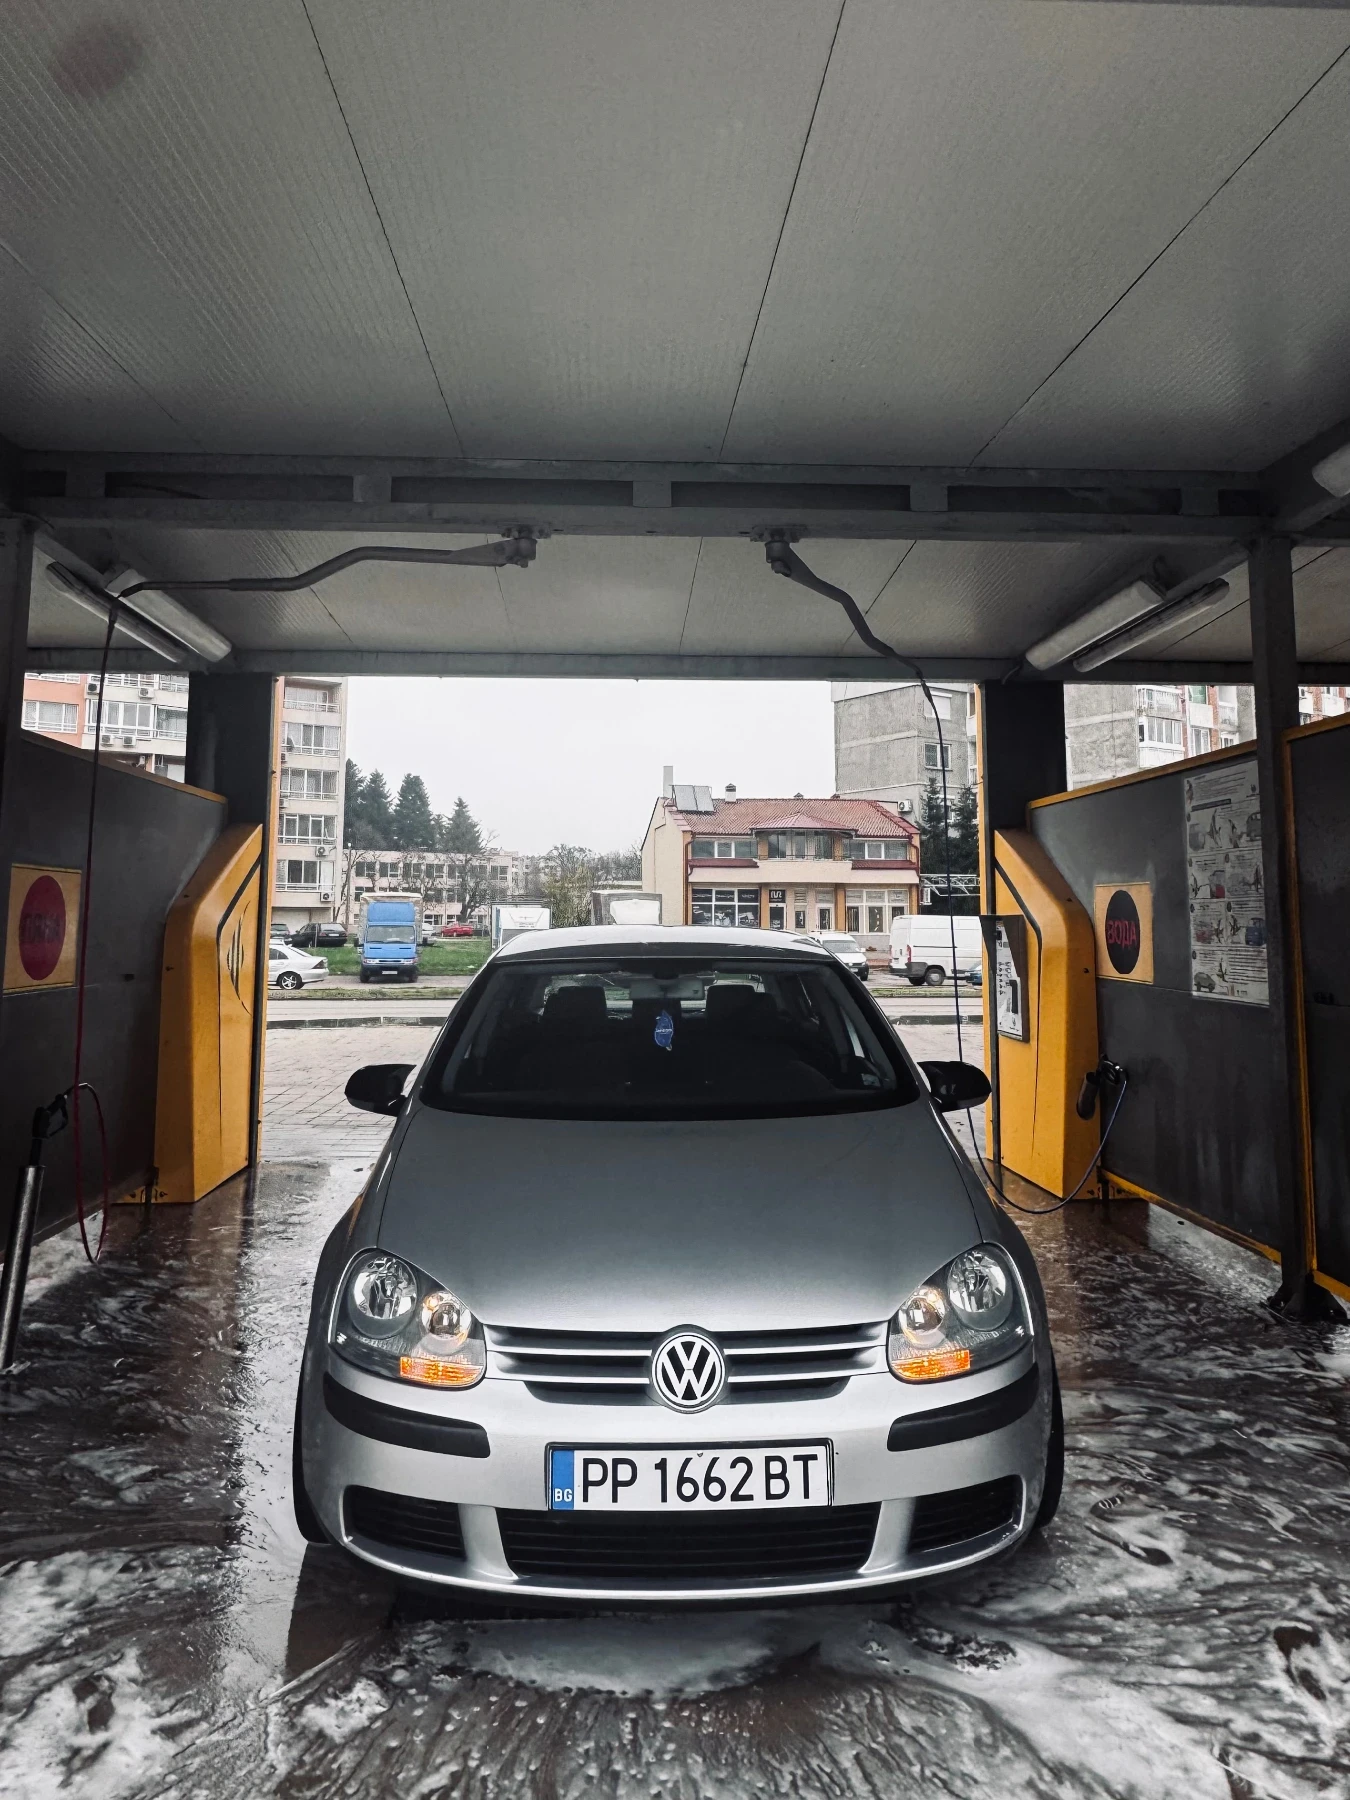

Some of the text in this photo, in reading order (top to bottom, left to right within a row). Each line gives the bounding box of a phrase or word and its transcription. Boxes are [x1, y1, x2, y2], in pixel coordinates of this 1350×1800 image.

[582, 1453, 818, 1503] PP 1662 BT
[554, 1488, 573, 1502] BG
